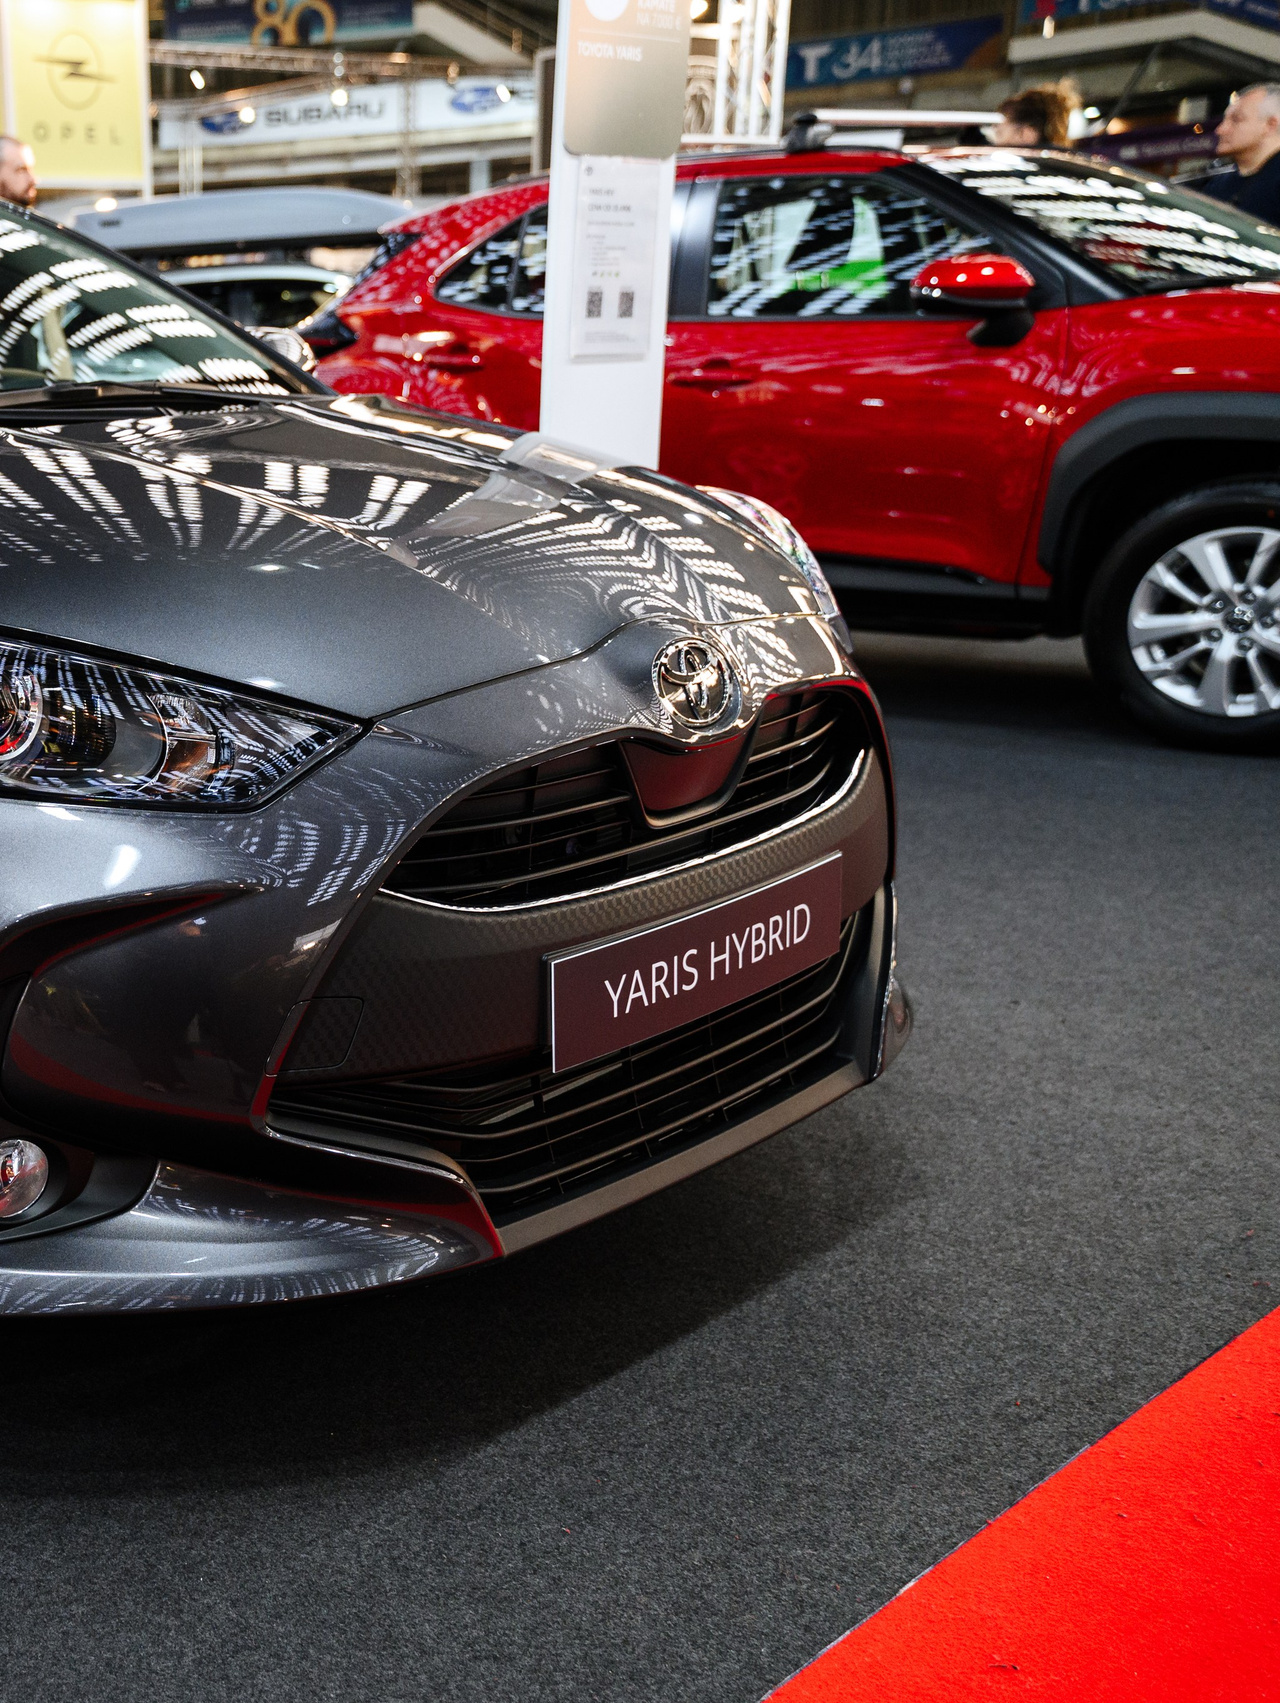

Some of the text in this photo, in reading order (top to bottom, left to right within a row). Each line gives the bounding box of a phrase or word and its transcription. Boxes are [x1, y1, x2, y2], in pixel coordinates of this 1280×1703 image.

[577, 41, 642, 62] TOYOTA YARIS
[265, 100, 387, 128] SUBARU
[32, 121, 123, 146] OPEL
[603, 903, 811, 1018] YARIS HYBRID
